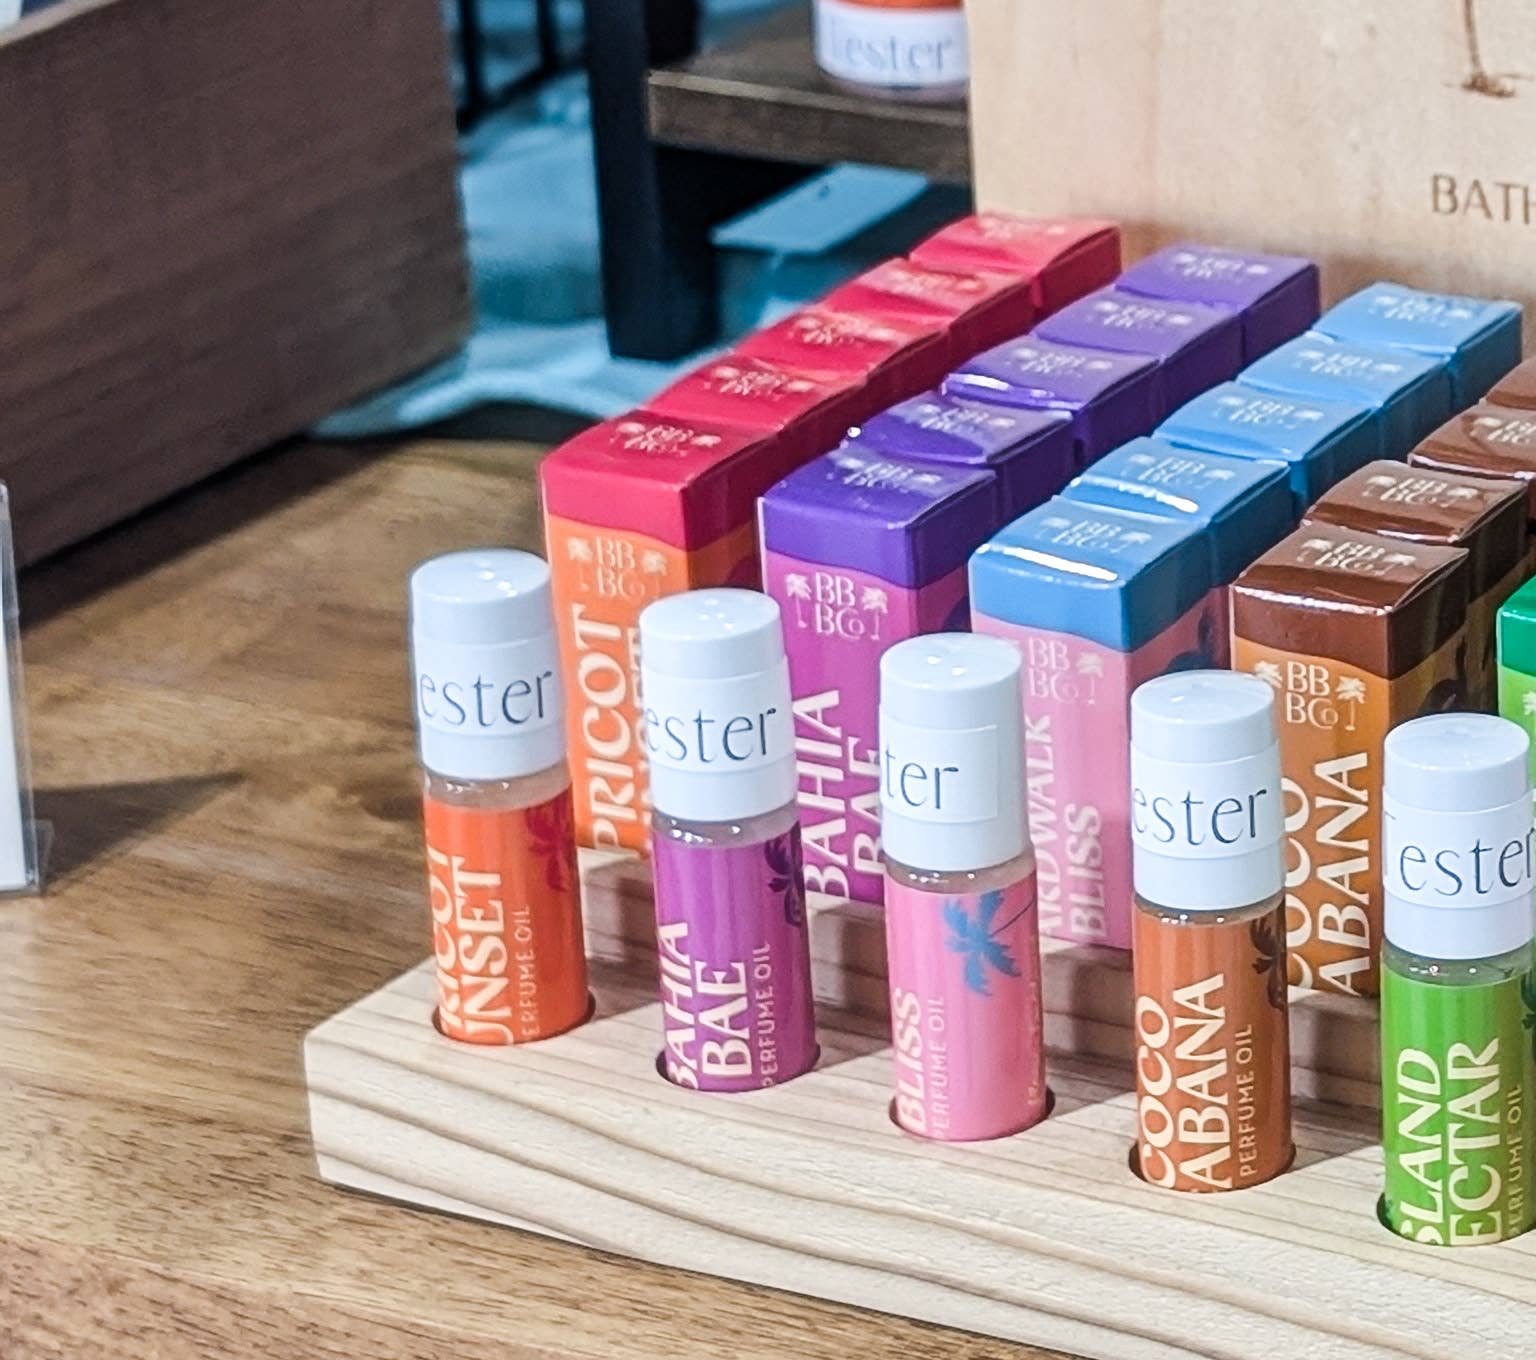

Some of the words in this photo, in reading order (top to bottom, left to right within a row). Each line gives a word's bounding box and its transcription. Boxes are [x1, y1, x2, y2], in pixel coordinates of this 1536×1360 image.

[832, 17, 952, 73] Tester
[815, 571, 857, 608] BB
[1027, 637, 1071, 671] BB
[1286, 660, 1331, 697] BB
[419, 670, 553, 728] ester
[644, 706, 778, 764] ester
[792, 689, 851, 899] BAHIA
[1132, 785, 1268, 847] ester
[1064, 802, 1108, 938] BLISS
[1313, 751, 1371, 997] ABANA
[1385, 814, 1536, 897] ester
[511, 905, 533, 943] OIL
[752, 942, 772, 980] OIL
[657, 921, 700, 1090] BAHIA
[695, 960, 753, 1080] BAE
[926, 996, 947, 1033] OIL
[755, 985, 779, 1089] PERFUME
[893, 986, 927, 1135] BLISS
[1234, 1023, 1254, 1066] OIL
[1136, 994, 1178, 1189] COCO
[1504, 1083, 1523, 1124] OIL
[1235, 1069, 1258, 1178] PERFUME
